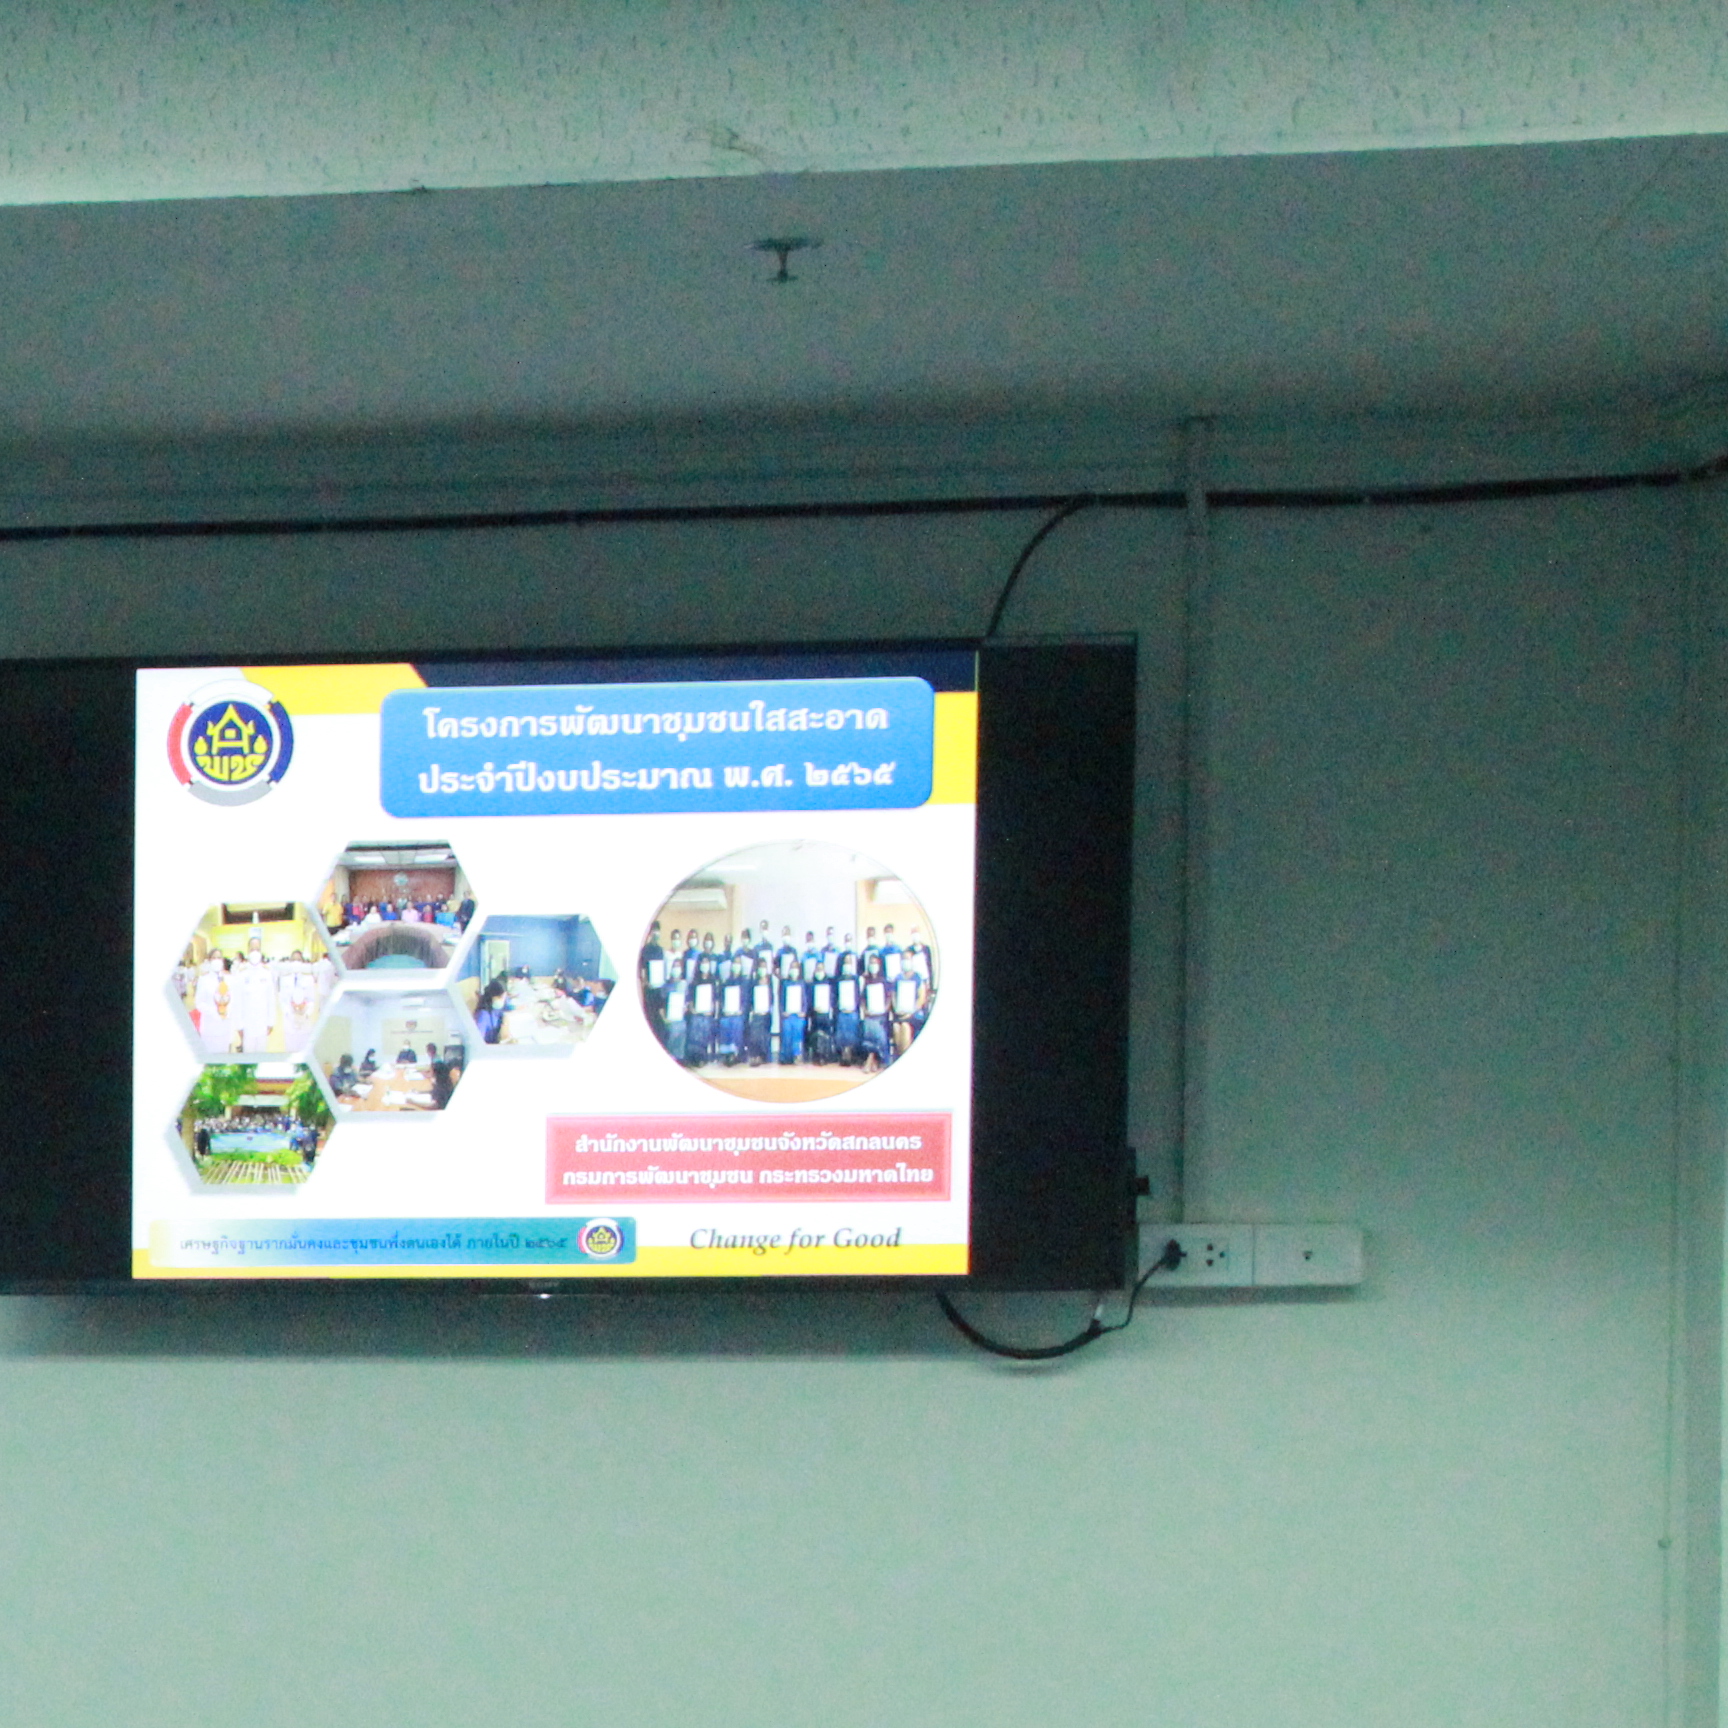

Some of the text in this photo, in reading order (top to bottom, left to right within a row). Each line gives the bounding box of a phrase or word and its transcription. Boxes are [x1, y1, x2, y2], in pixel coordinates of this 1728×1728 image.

[422, 700, 890, 742] โครงการพัฒนาชุมชนใสสะอาด
[418, 760, 896, 794] ประจำปีงบประมาณ พ.ศ. ๒๕๖๕
[575, 1131, 922, 1157] สำนักงานพัฒนาชุมชนจังหวัดสกลนคร
[562, 1162, 935, 1189] กรมการพัฒนาชุมชน กระทรวงมหาดไทย
[689, 1226, 904, 1256] Change for Good
